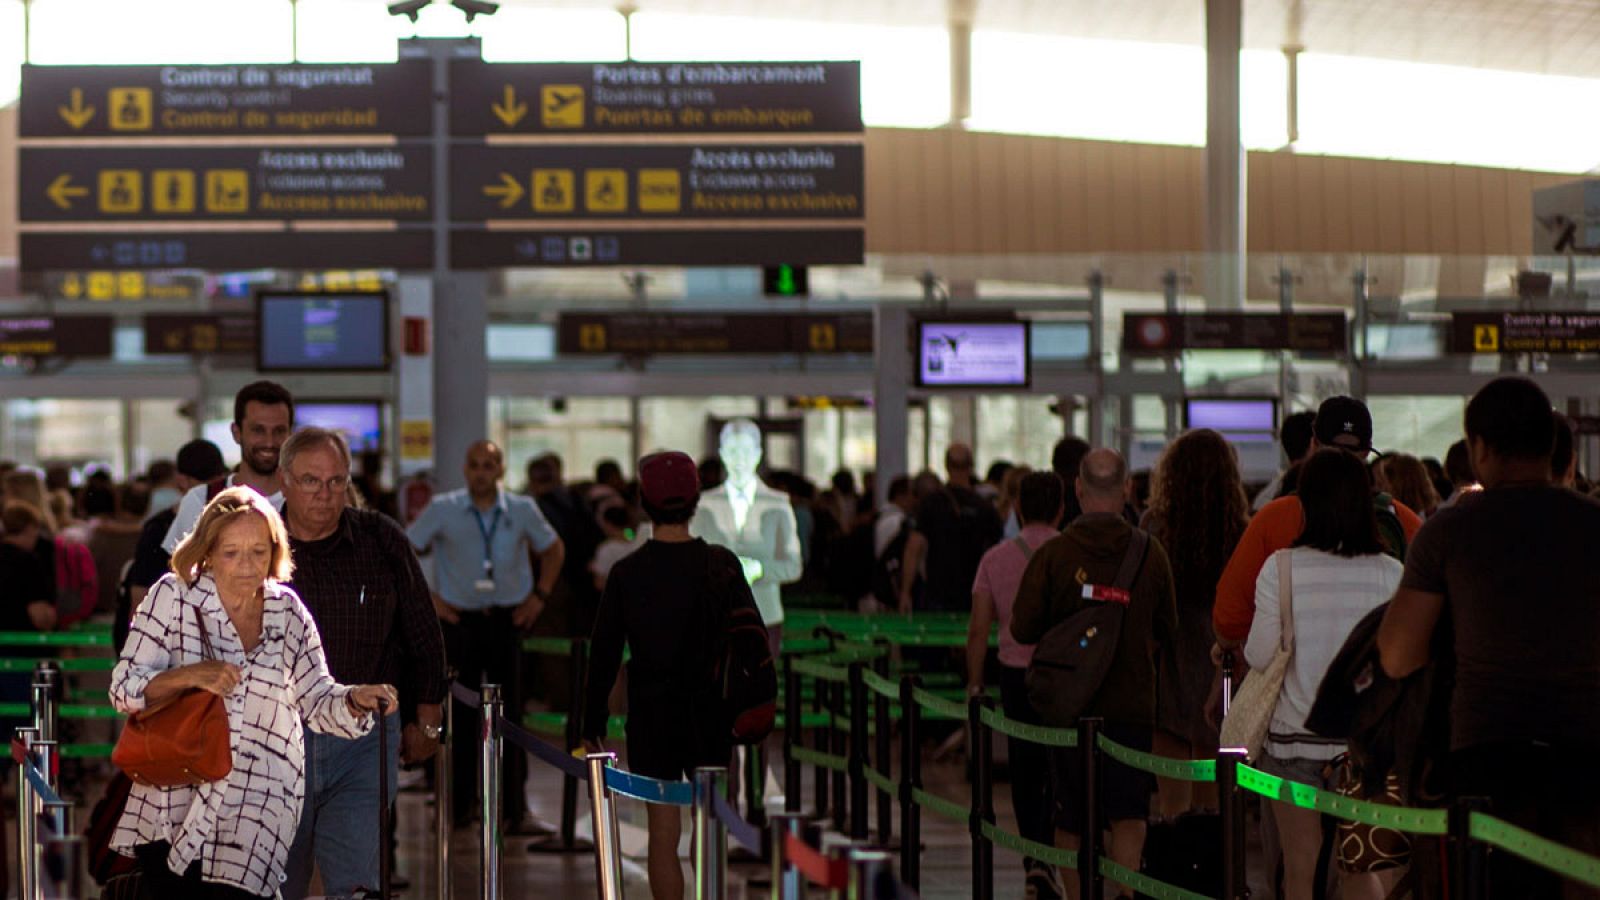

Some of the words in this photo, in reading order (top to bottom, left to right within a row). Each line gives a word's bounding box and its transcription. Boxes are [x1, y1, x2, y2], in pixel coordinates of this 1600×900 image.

[160, 66, 238, 86] Control
[241, 66, 270, 86] de
[274, 66, 374, 89] seguretat
[592, 64, 662, 84] Portes
[666, 63, 827, 84] d'embarcament
[161, 109, 238, 128] Control
[242, 109, 270, 127] de
[275, 108, 378, 130] seguridad
[594, 106, 673, 126] Puertas
[680, 106, 705, 125] de
[711, 106, 814, 128] embarque
